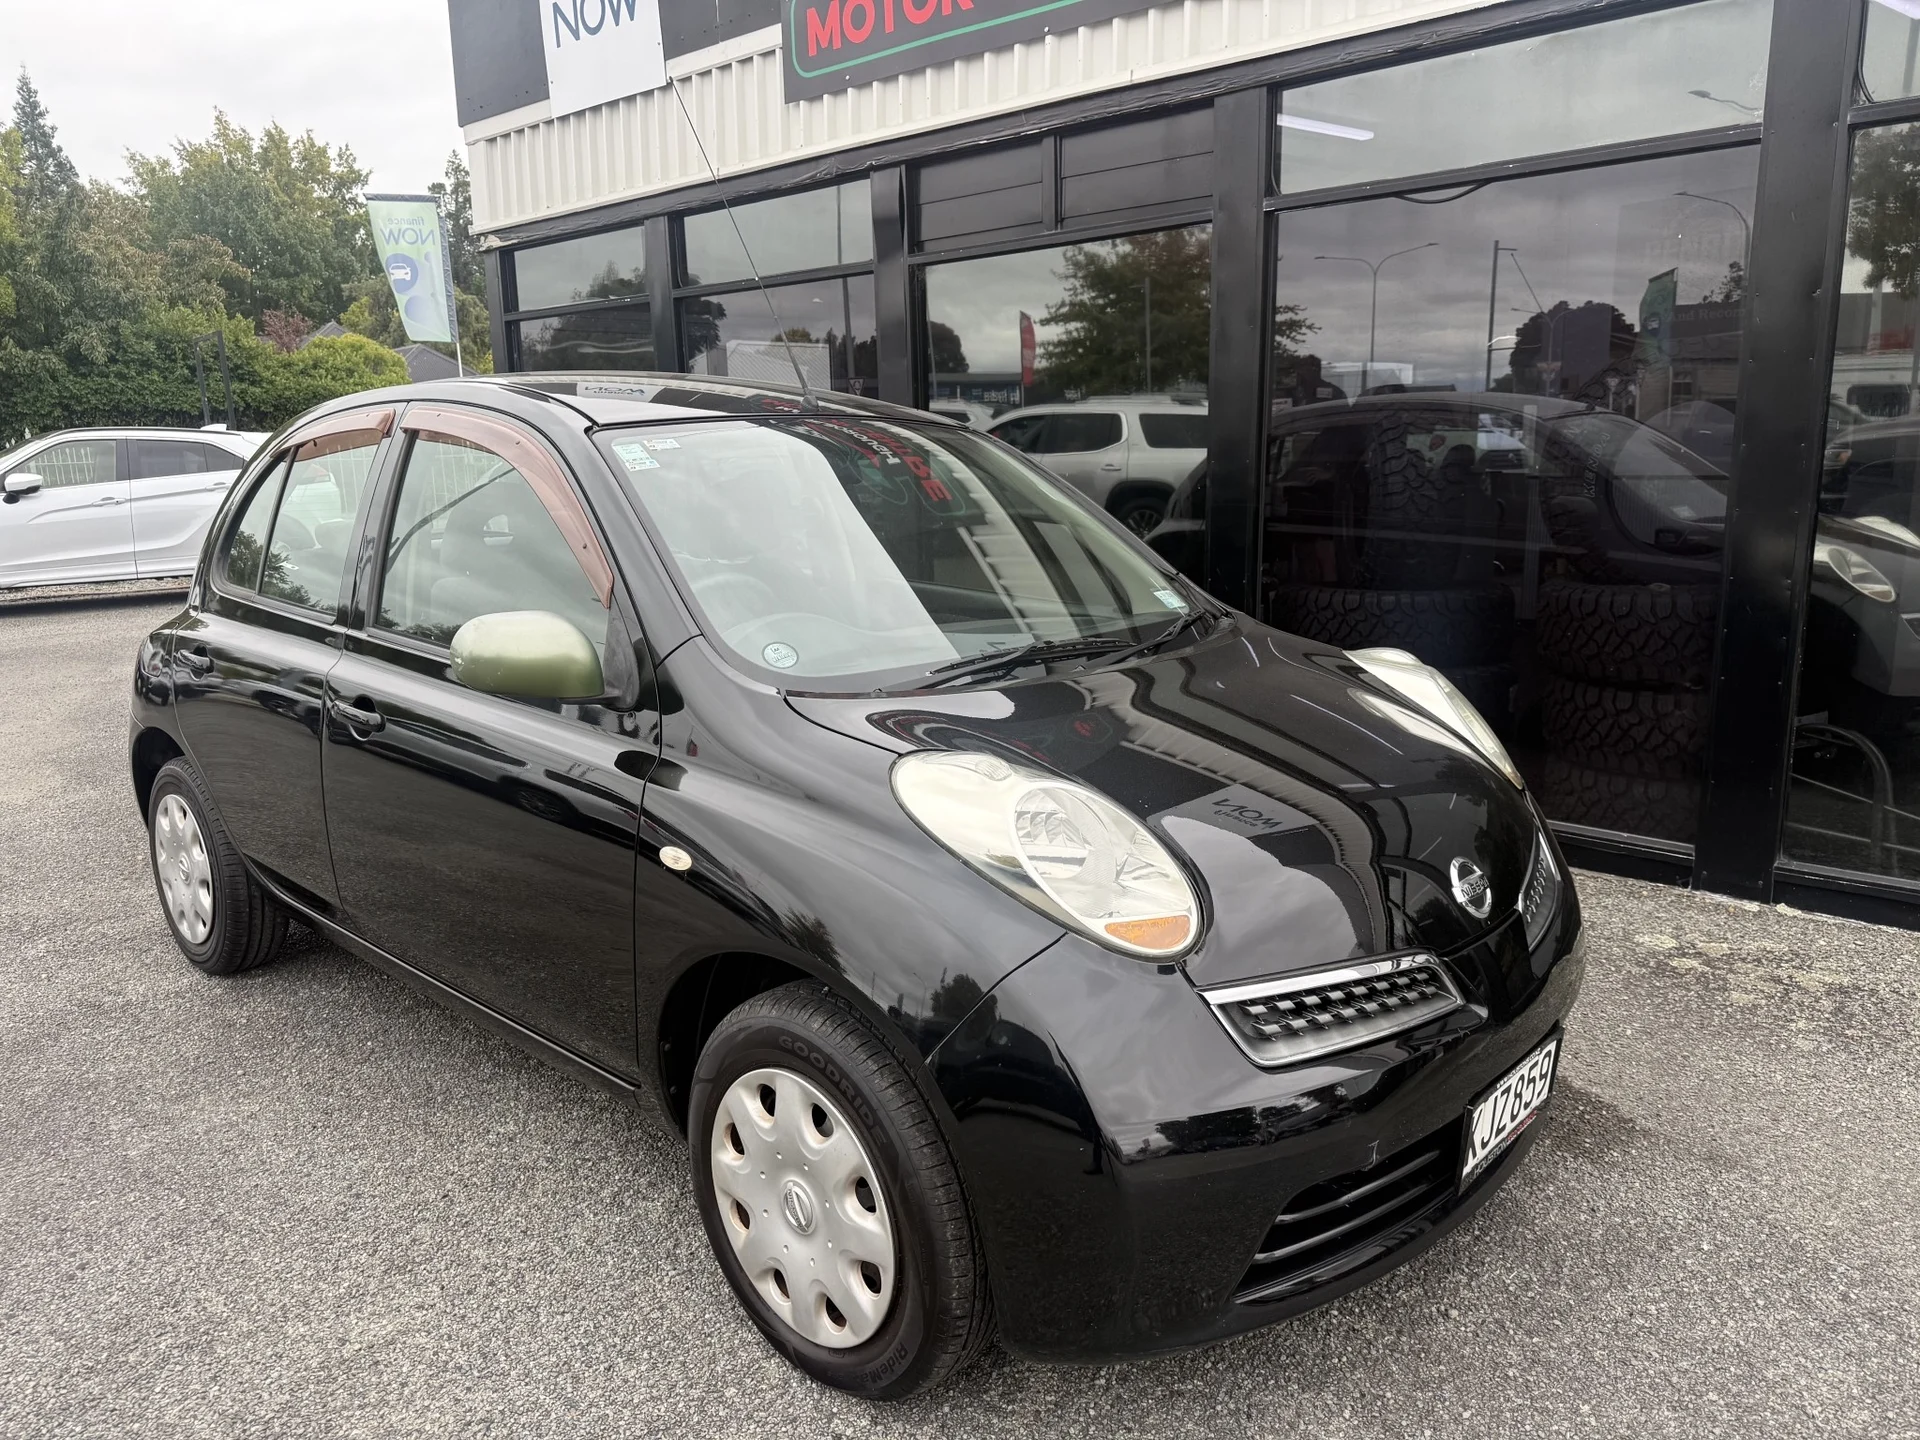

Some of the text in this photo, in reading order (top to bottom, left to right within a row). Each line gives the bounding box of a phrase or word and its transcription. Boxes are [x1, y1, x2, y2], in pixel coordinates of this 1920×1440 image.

[552, 0, 637, 48] NOW
[1461, 875, 1490, 900] NISSAN
[778, 1034, 887, 1144] GOODRIDE
[1463, 1048, 1553, 1169] KJZ859
[860, 1341, 909, 1385] RideMa
